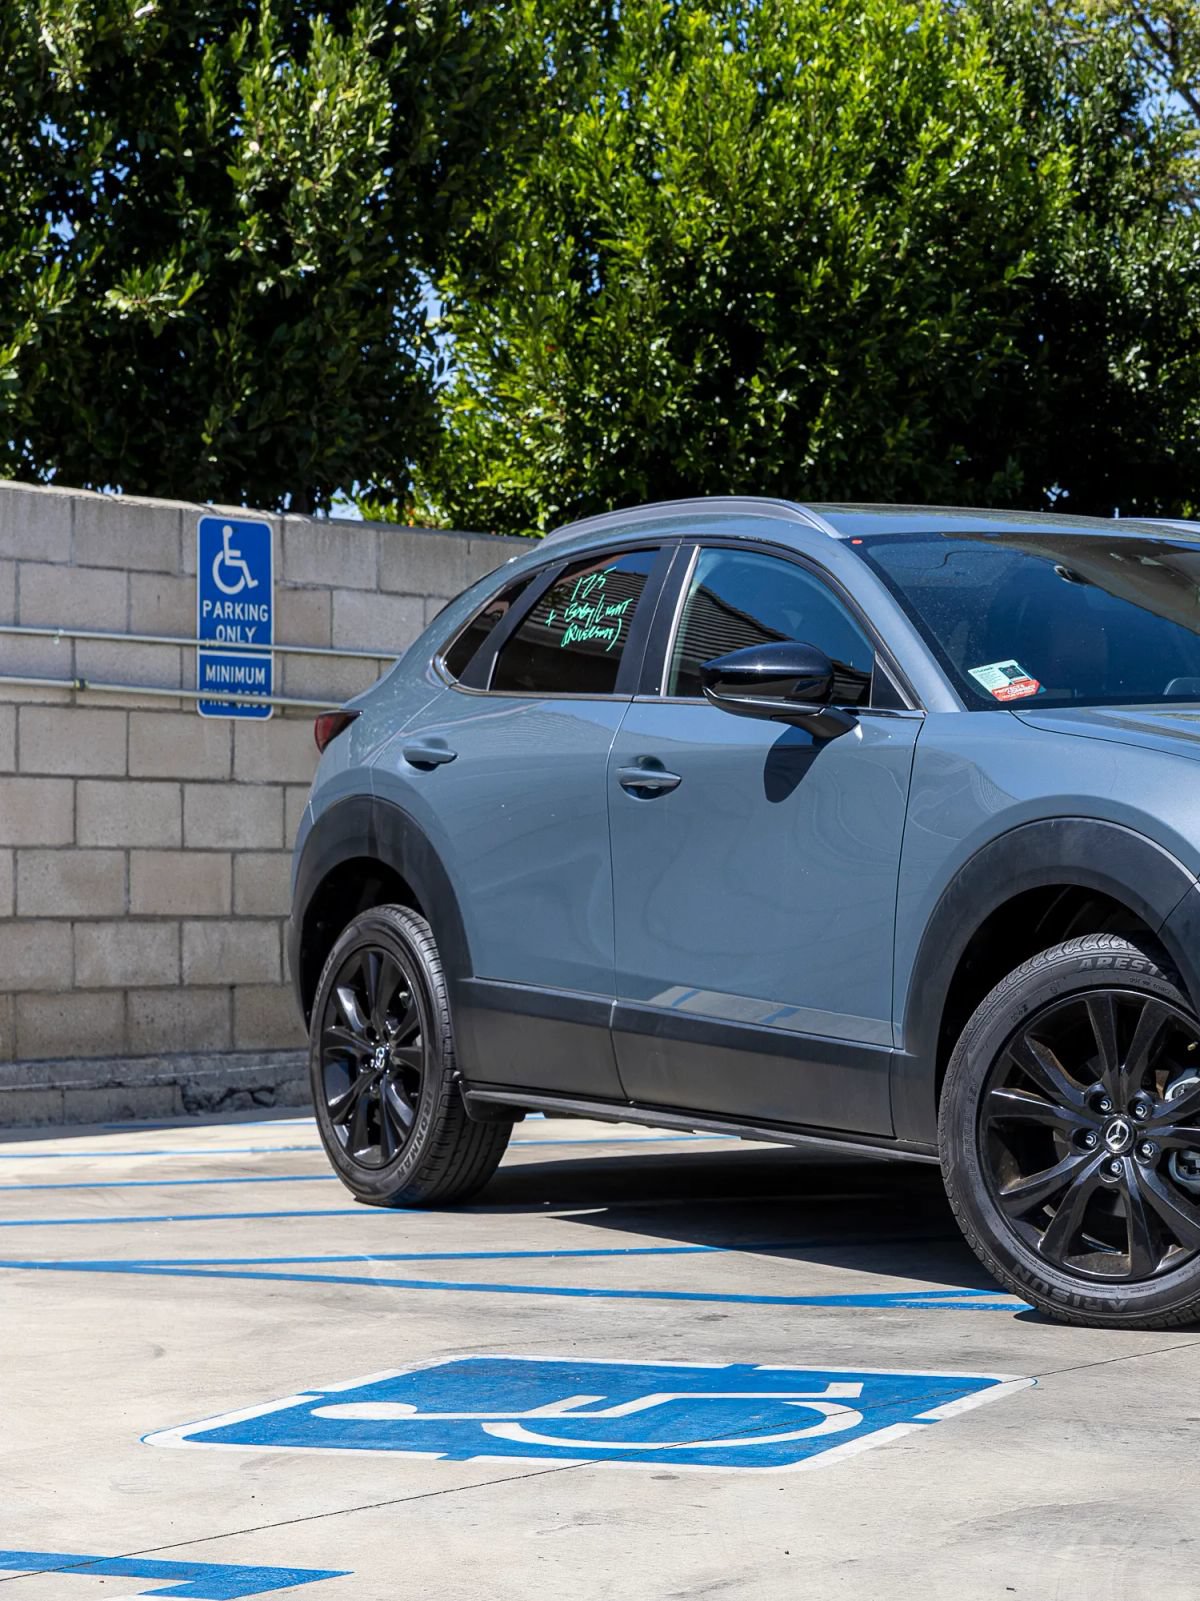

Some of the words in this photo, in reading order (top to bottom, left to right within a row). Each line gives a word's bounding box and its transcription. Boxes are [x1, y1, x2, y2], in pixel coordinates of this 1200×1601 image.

[202, 600, 269, 622] PARKING
[216, 625, 258, 644] ONLY
[205, 664, 266, 685] MINIMUM
[1079, 956, 1168, 981] AREST
